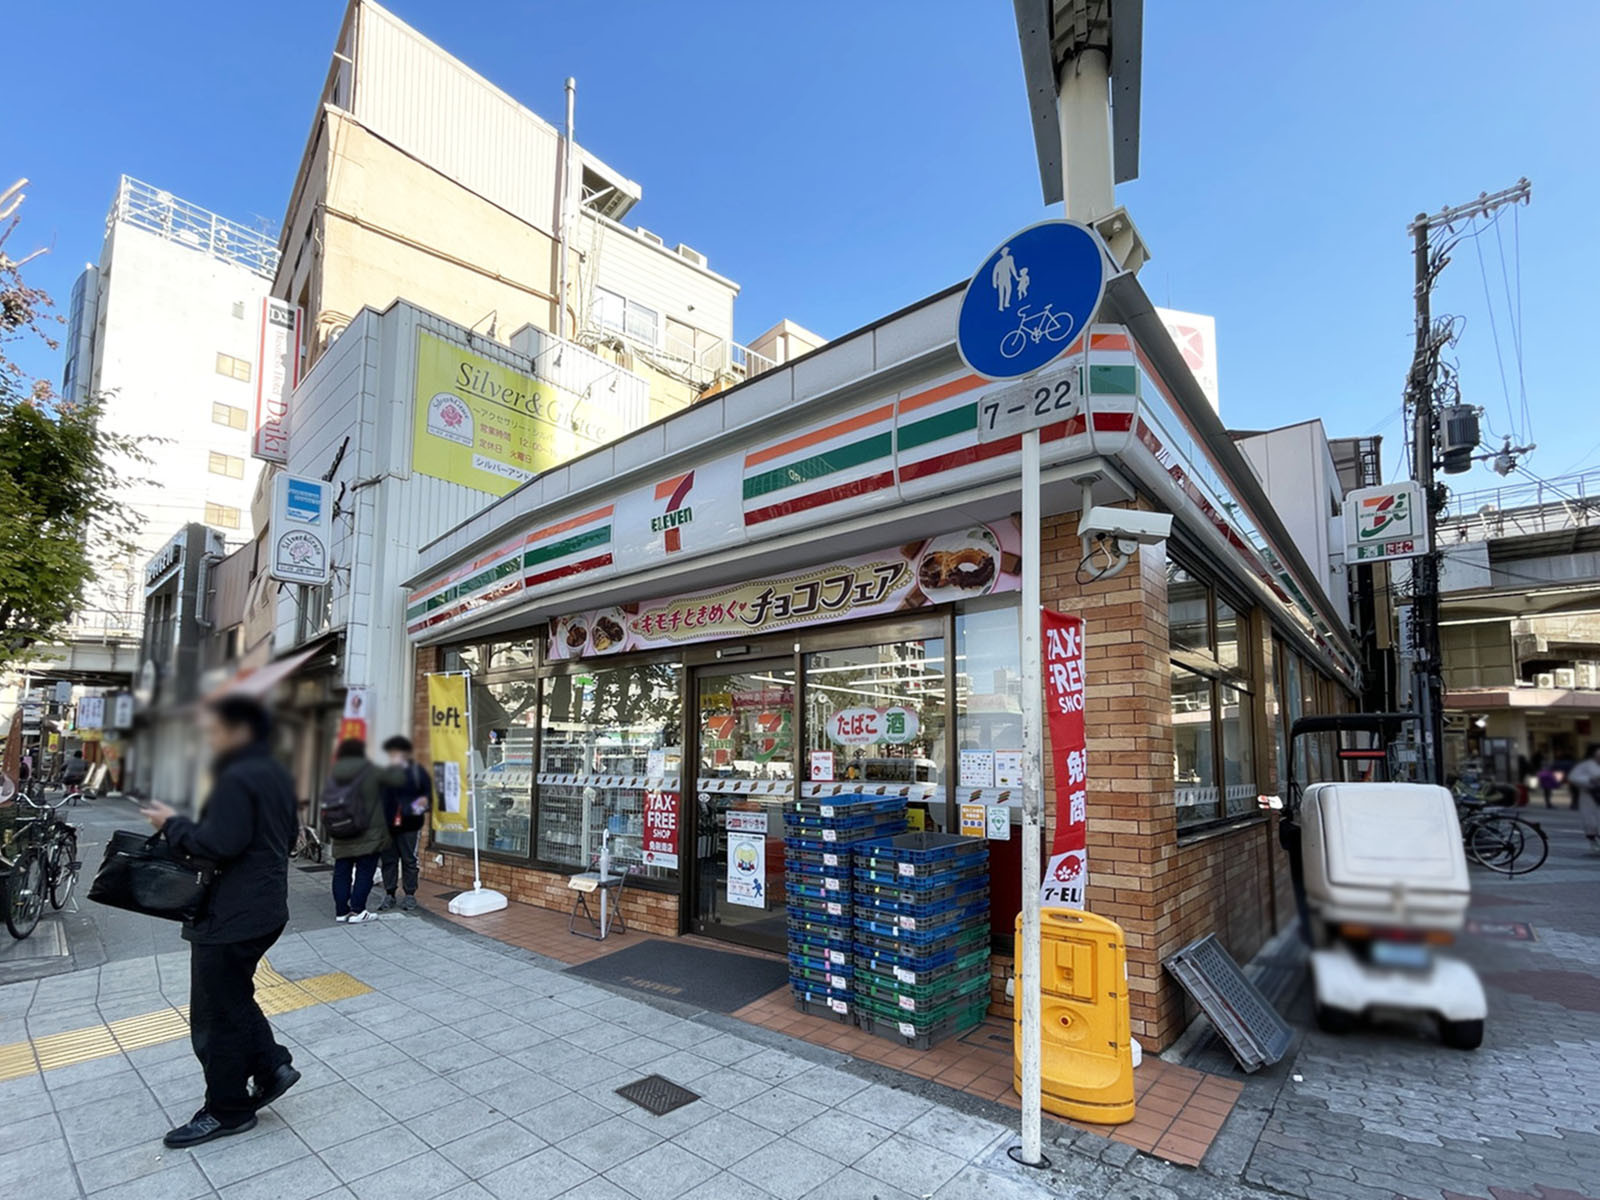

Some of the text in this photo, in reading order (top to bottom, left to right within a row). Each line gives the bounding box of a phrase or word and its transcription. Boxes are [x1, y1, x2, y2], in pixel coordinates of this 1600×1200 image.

[265, 399, 288, 452] Daiki
[1387, 541, 1413, 555] たばこ
[641, 563, 905, 633] キモチときめく チョコフェア
[1058, 693, 1083, 714] SHO
[837, 712, 905, 736] たばこ 酒
[648, 794, 677, 811] TAX-
[647, 811, 676, 829] FREE
[652, 828, 671, 839] SHOP
[1044, 887, 1082, 903] 7-EL
